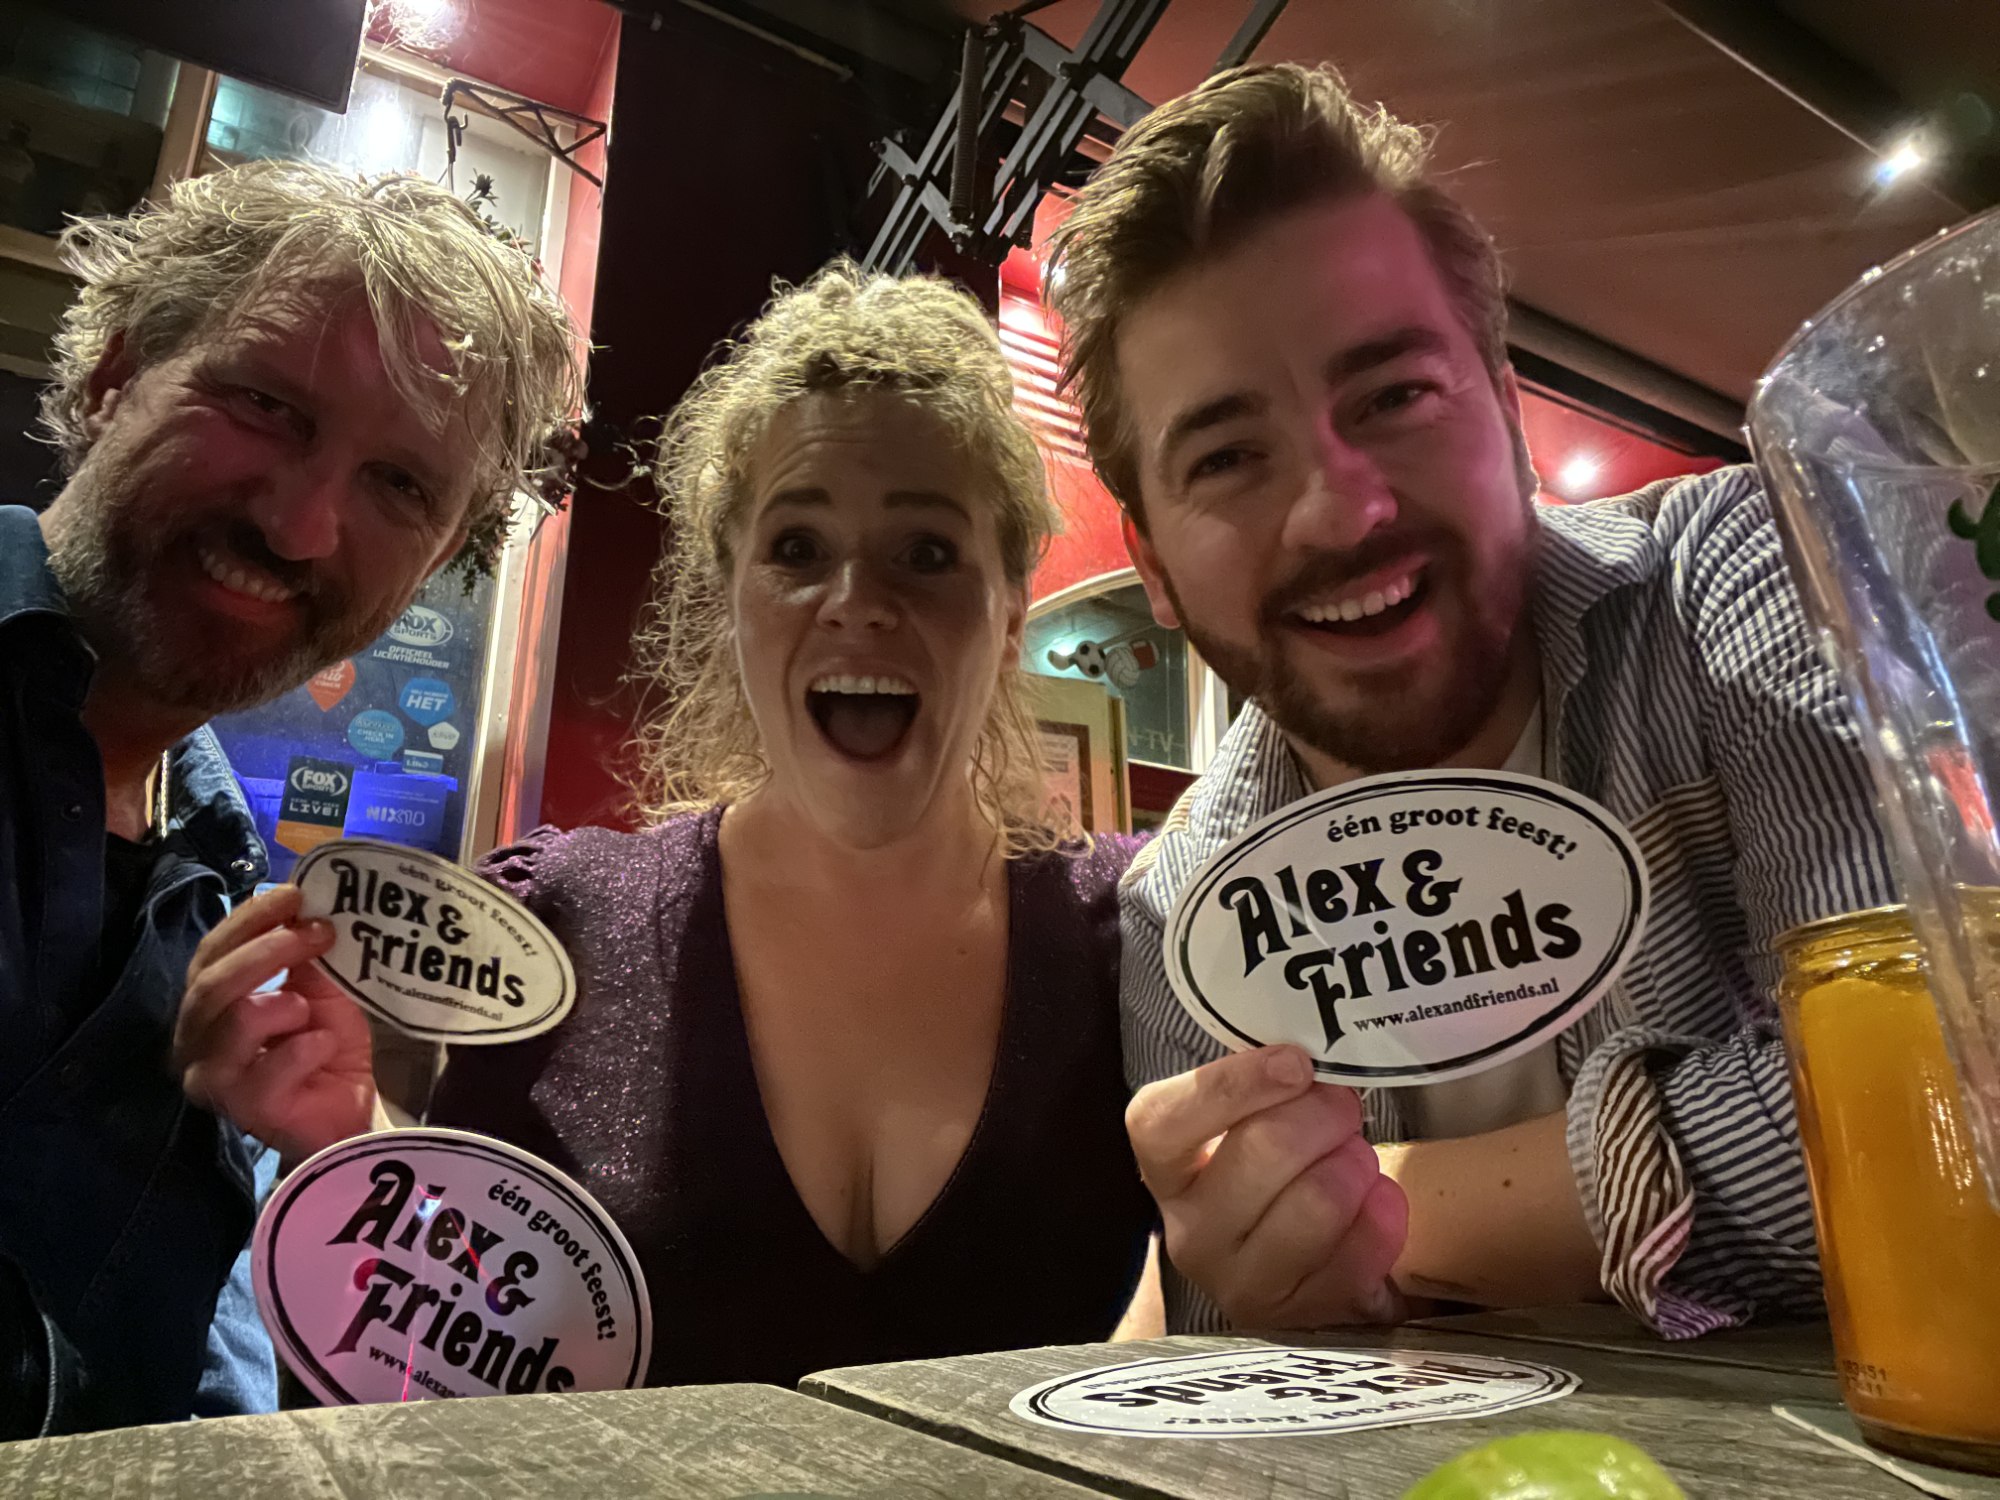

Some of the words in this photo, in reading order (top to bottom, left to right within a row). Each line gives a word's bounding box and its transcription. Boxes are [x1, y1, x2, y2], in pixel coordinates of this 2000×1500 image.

[373, 649, 450, 670] LICENTIEHOUDER
[388, 645, 433, 660] OFFICIEEL
[406, 694, 447, 712] HET
[302, 769, 337, 789] FOX
[302, 783, 336, 794] SPORTS
[1327, 815, 1384, 844] één
[1390, 805, 1481, 835] groot
[1486, 806, 1579, 861] feest!
[330, 857, 431, 927] Alex
[436, 903, 471, 946] &
[434, 877, 489, 912] groot
[490, 907, 538, 957] feest!
[1218, 857, 1397, 979] Alex
[1401, 848, 1463, 918] &
[351, 920, 527, 1008] Friends
[1283, 888, 1583, 1055] Friends
[376, 975, 503, 1022] www.alexandfriends.nl
[1352, 977, 1560, 1034] www.alexandfriends.nl
[327, 1159, 505, 1284] Alex
[485, 1250, 540, 1317] &
[487, 1179, 532, 1217] één
[527, 1208, 592, 1268] groot
[580, 1263, 617, 1342] feest!
[325, 1257, 576, 1395] Friends
[1081, 1353, 1396, 1408] Friends
[1264, 1386, 1362, 1404] &
[1330, 1360, 1535, 1396] Alex
[1162, 1415, 1308, 1426] feest!
[1309, 1401, 1420, 1421] groot
